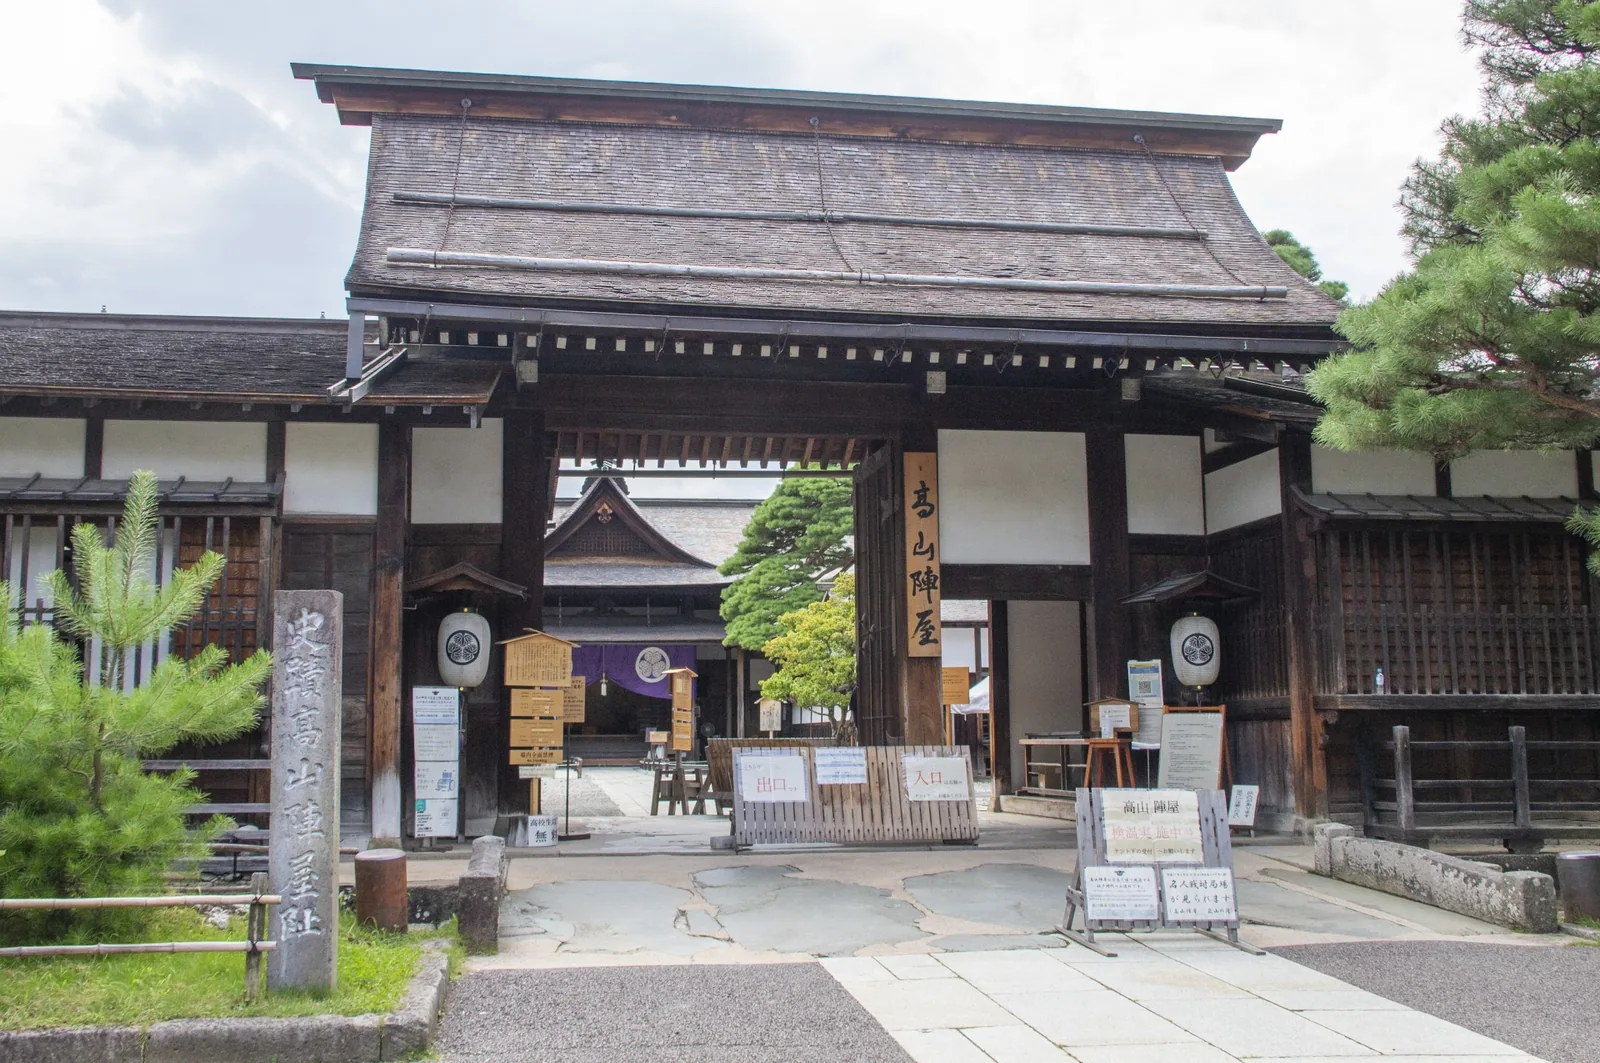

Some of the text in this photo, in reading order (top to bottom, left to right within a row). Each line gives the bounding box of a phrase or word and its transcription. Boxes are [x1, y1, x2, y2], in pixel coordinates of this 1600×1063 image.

[909, 480, 939, 646] 高山陣屋
[757, 776, 786, 793] 出口
[914, 770, 942, 786] 入口
[1122, 800, 1180, 814] 高山陣屋
[1112, 825, 1182, 840] 検温実施中
[1169, 879, 1228, 890] 名人戦対局場
[1170, 894, 1230, 904] が見られます
